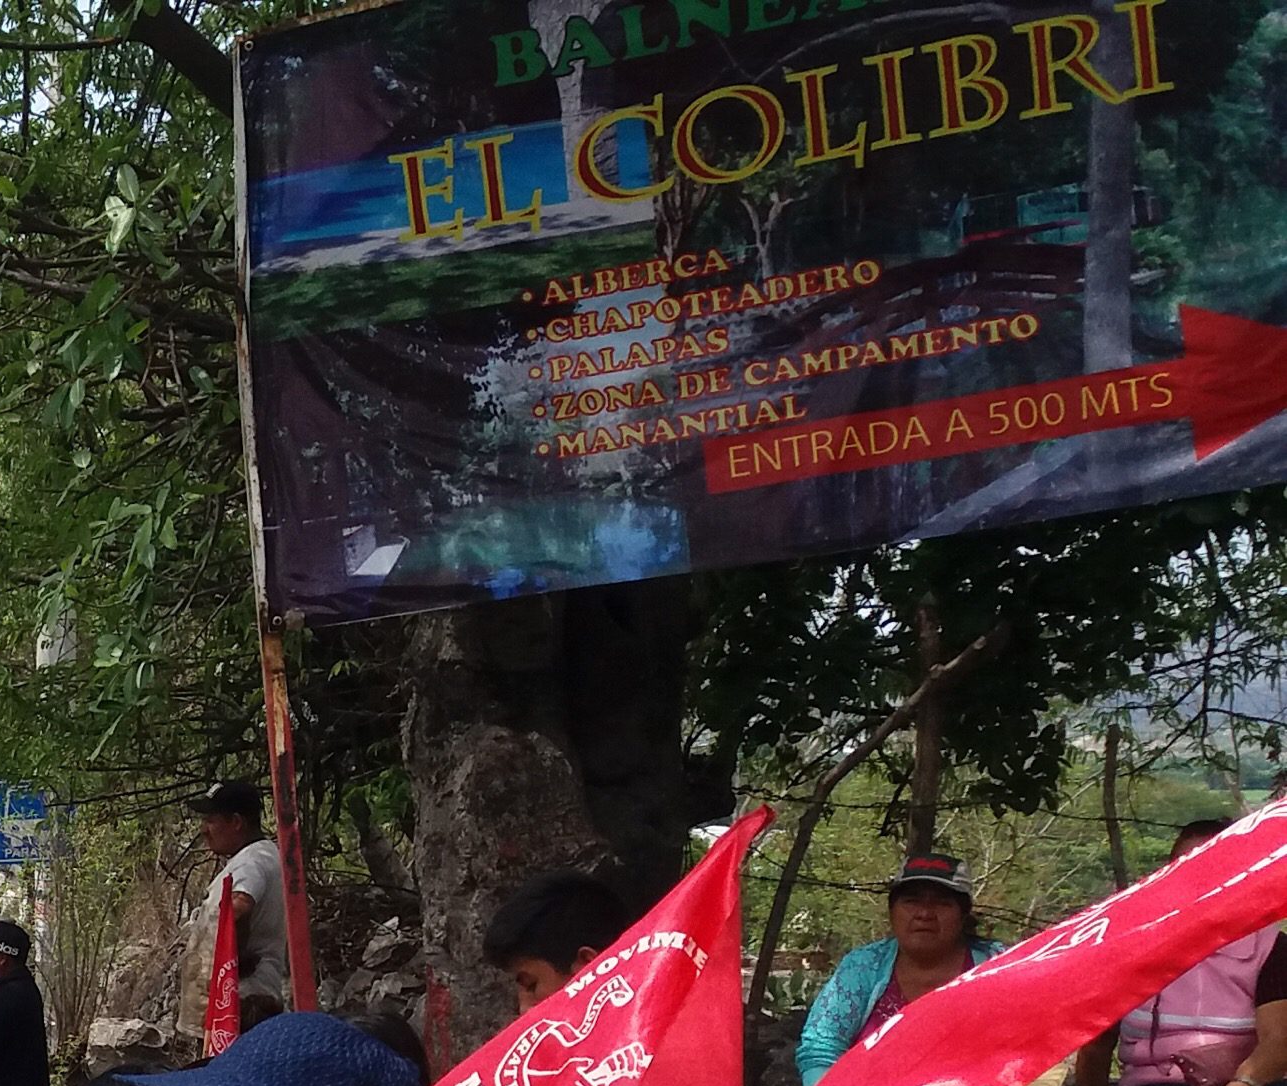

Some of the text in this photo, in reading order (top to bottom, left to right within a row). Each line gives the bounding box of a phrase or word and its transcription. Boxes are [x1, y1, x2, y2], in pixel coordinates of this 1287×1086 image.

[389, 0, 1175, 244] EL COLIBRI
[542, 248, 730, 306] ALBERCA
[544, 258, 882, 344] CHAPOTEADERO
[550, 327, 730, 382] PALAPAS
[552, 312, 1039, 421] ZONA DE CAMPAMENTO
[556, 394, 808, 458] MANANTIAL
[728, 372, 1174, 479] ENTRADA A 500 MTS
[565, 931, 709, 998] MOVIMIE
[579, 977, 621, 1035] UNION
